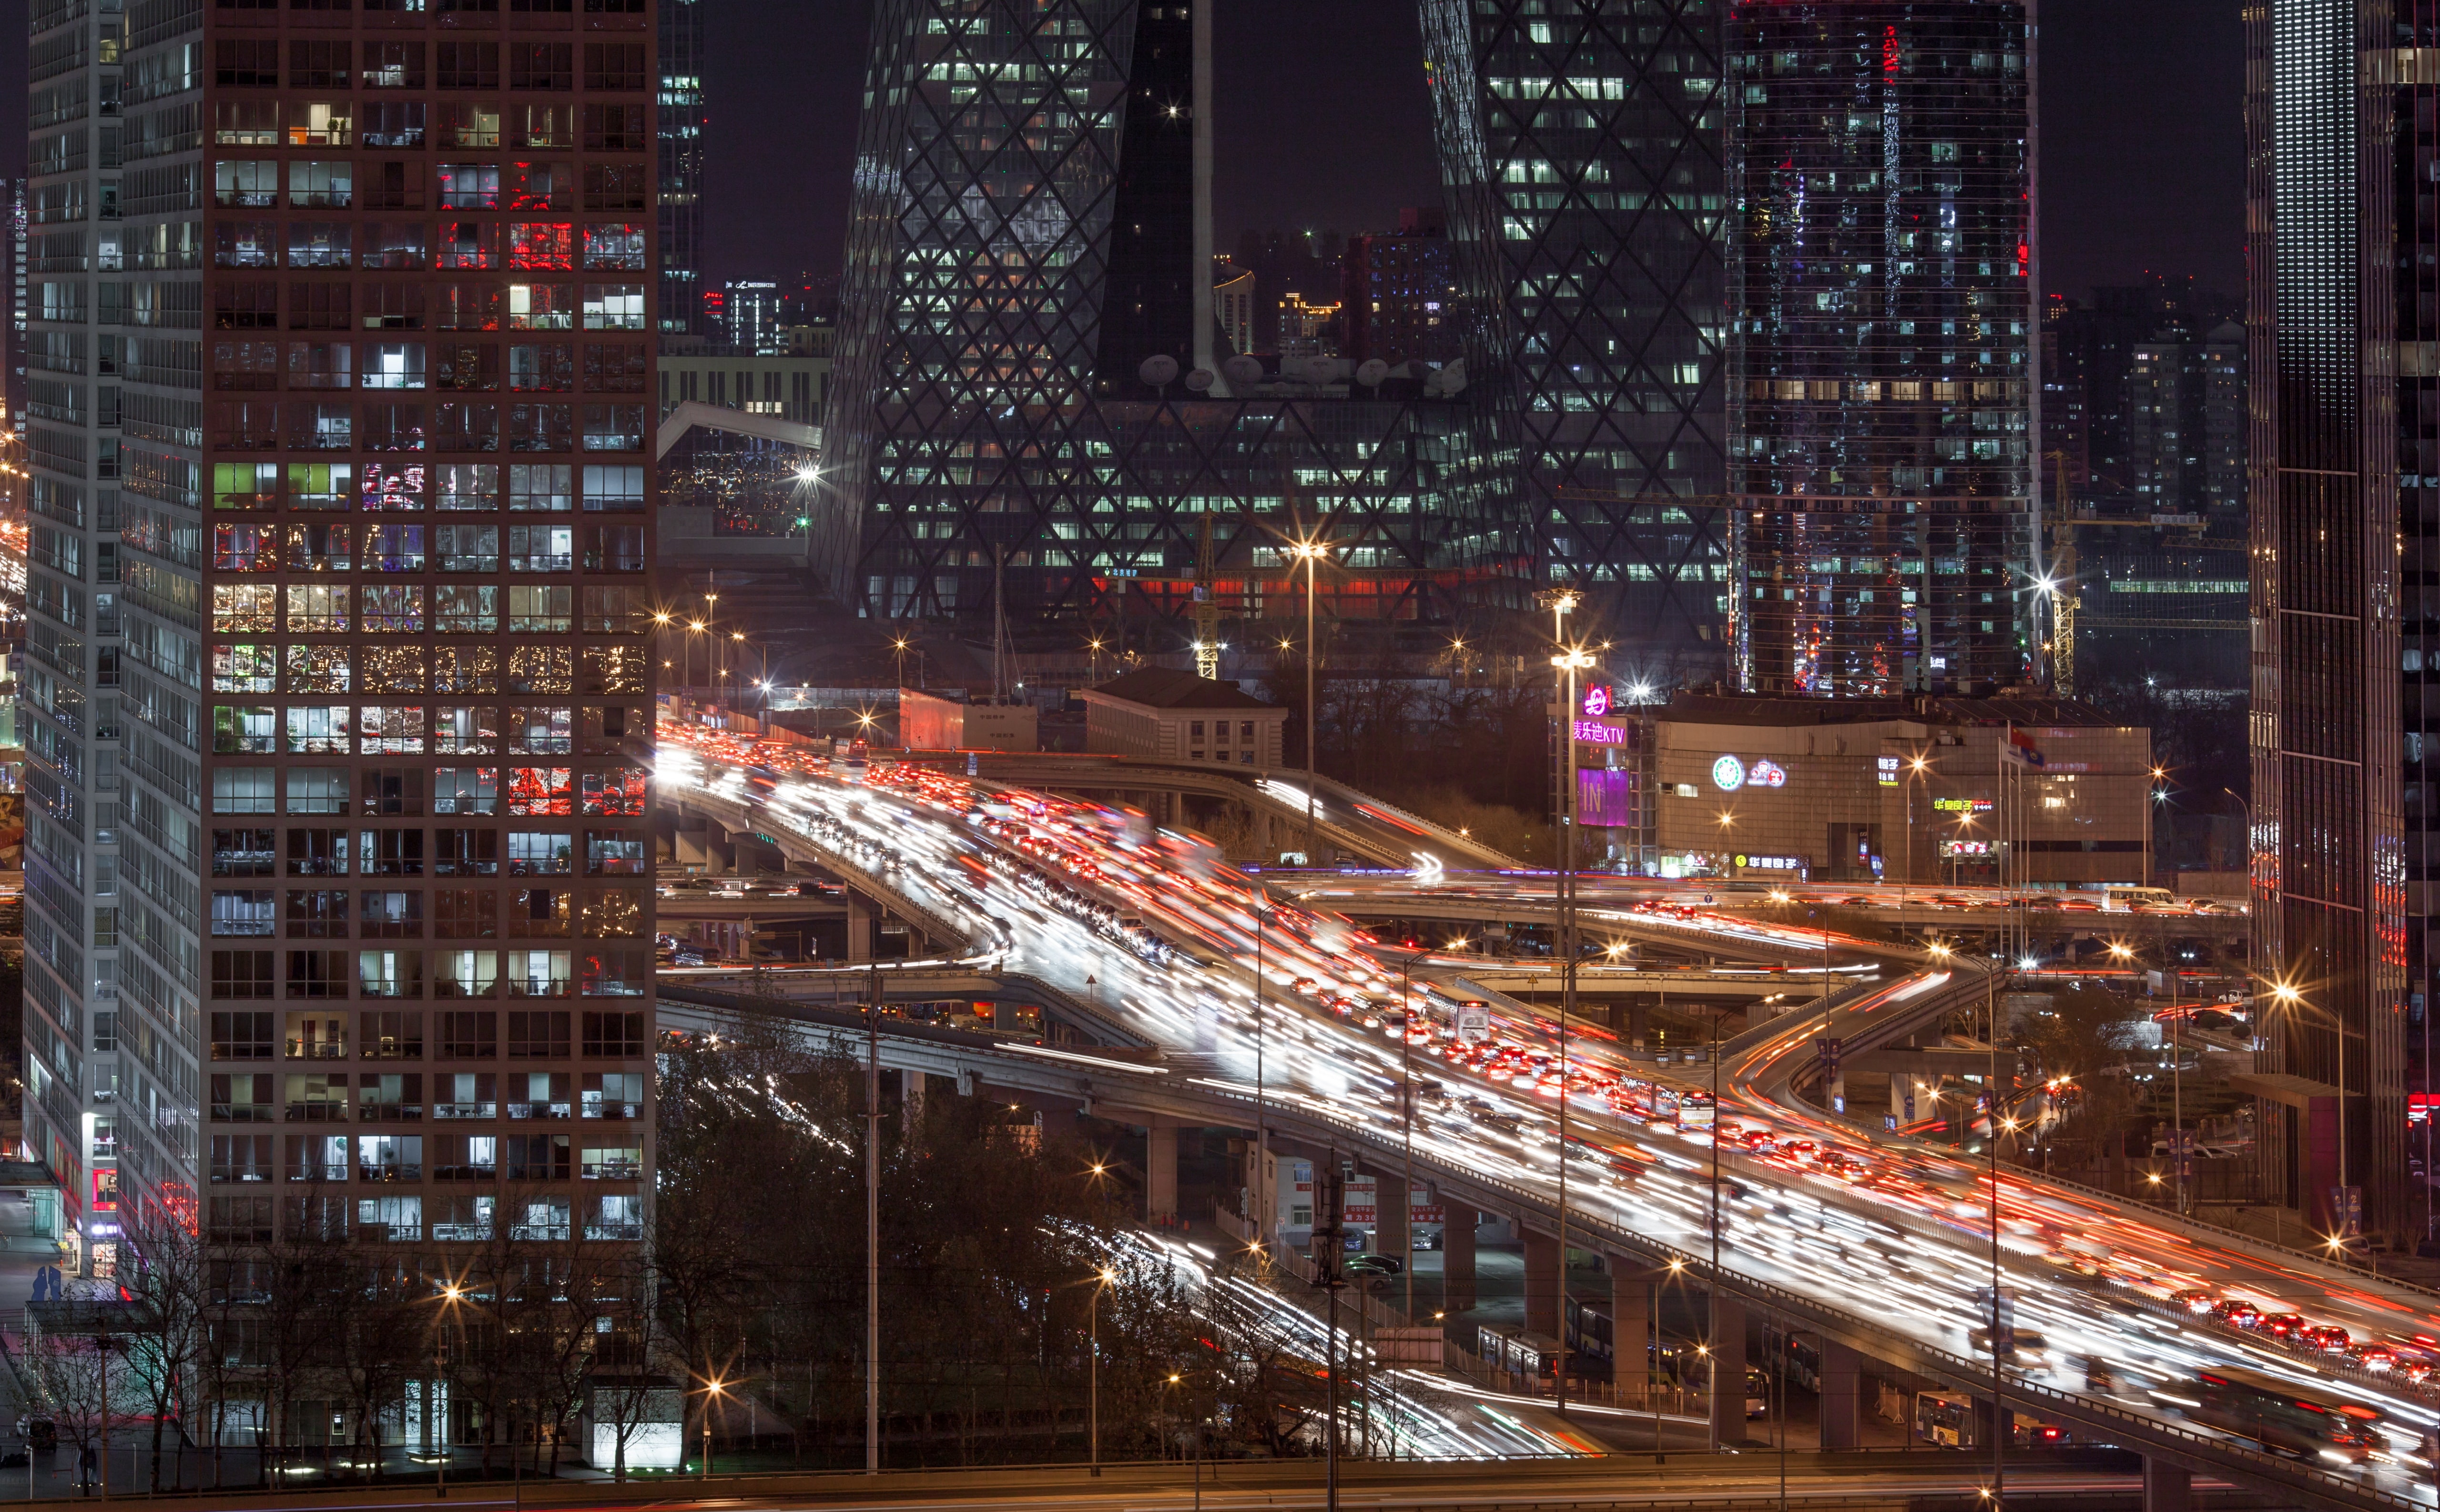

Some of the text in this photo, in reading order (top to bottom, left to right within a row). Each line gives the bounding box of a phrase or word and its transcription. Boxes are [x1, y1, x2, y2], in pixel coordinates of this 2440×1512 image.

[1574, 720, 1625, 743] 麦乐迪KTV
[1584, 782, 1601, 812] IN
[1934, 801, 1972, 810] 华夏良子
[1749, 857, 1797, 869] 华夏良子
